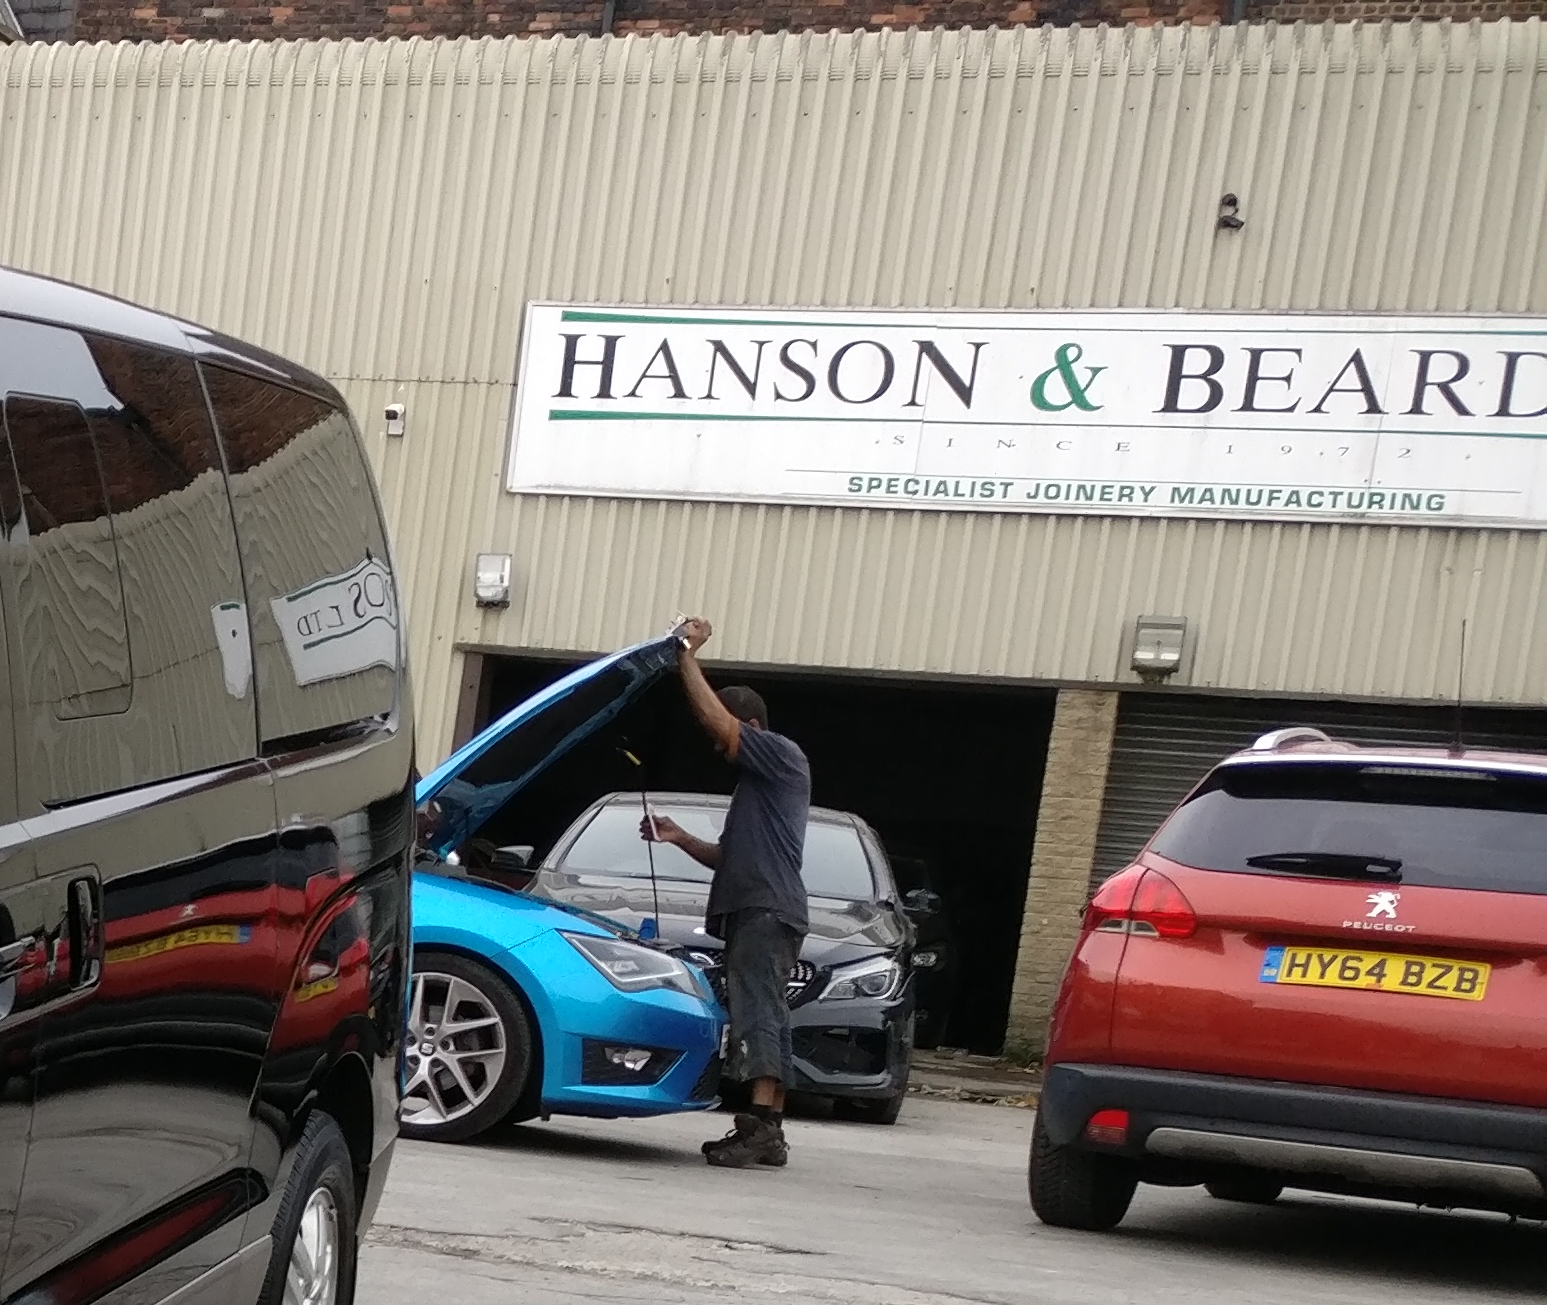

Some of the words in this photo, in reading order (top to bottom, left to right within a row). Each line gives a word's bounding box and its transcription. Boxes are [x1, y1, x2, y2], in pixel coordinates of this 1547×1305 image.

[551, 332, 990, 410] HANSON
[1028, 341, 1109, 412] &
[1152, 342, 1547, 418] BEARD
[847, 475, 1014, 499] SPECIALIST
[1025, 481, 1158, 504] JOINERY
[1169, 485, 1448, 512] MANUFACTURING
[1342, 920, 1416, 933] PEUGEOT
[1285, 951, 1388, 984] HY64
[1398, 959, 1481, 994] BZB
